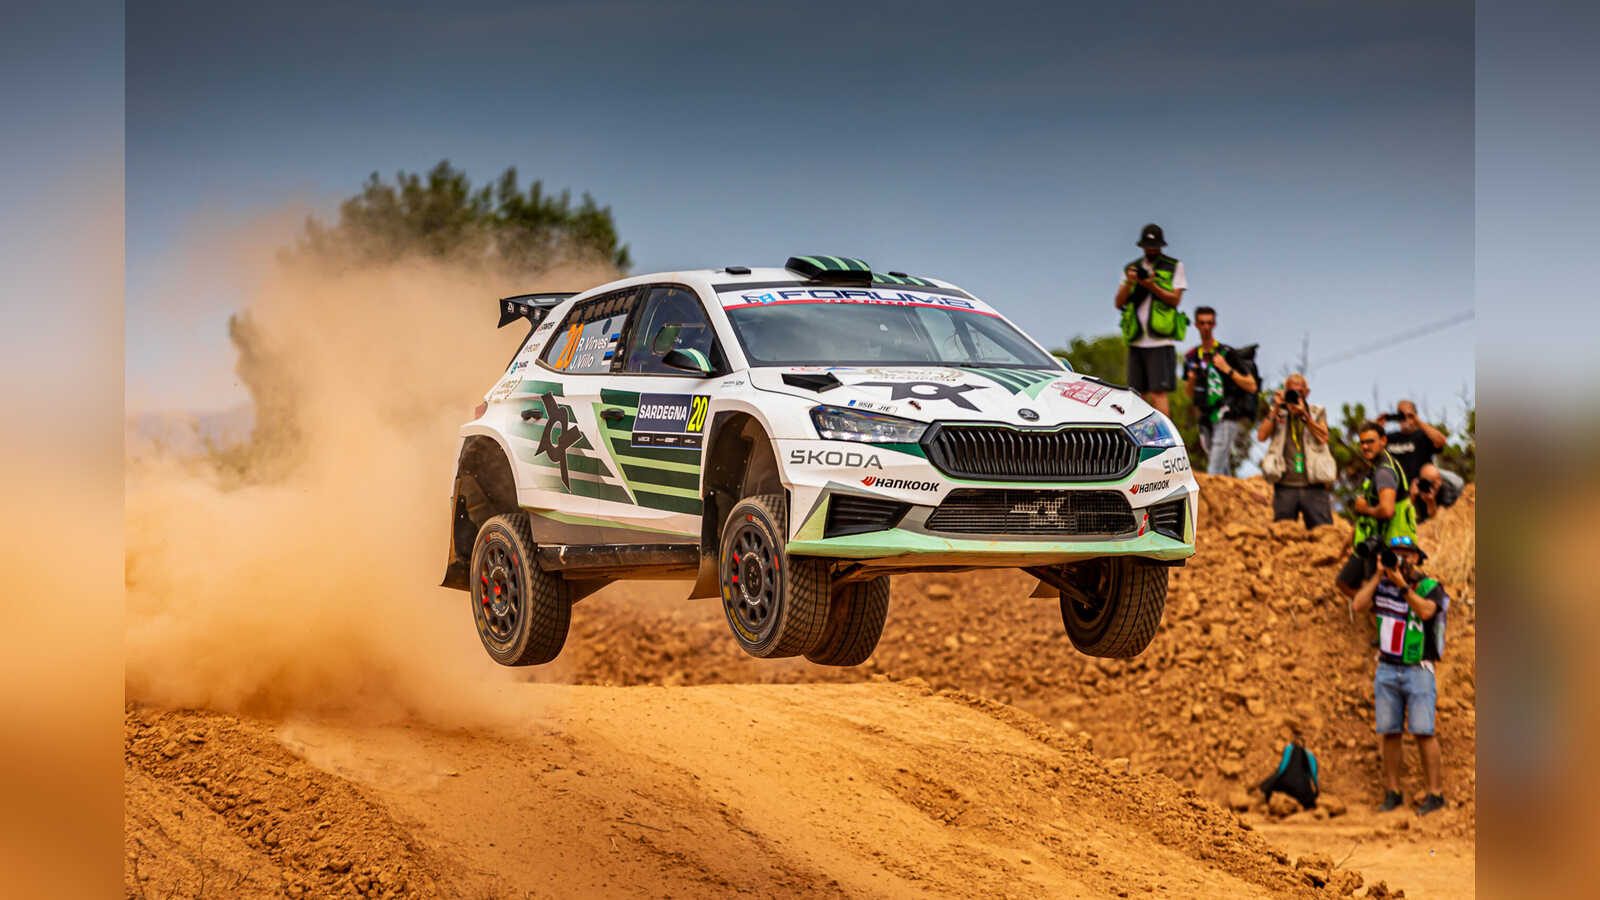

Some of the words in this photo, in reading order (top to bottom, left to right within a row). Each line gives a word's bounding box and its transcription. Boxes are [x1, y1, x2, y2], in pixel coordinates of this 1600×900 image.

[777, 290, 975, 309] FORUM8
[554, 323, 585, 369] 20
[639, 404, 688, 421] SARDEGNA
[687, 396, 708, 432] 20
